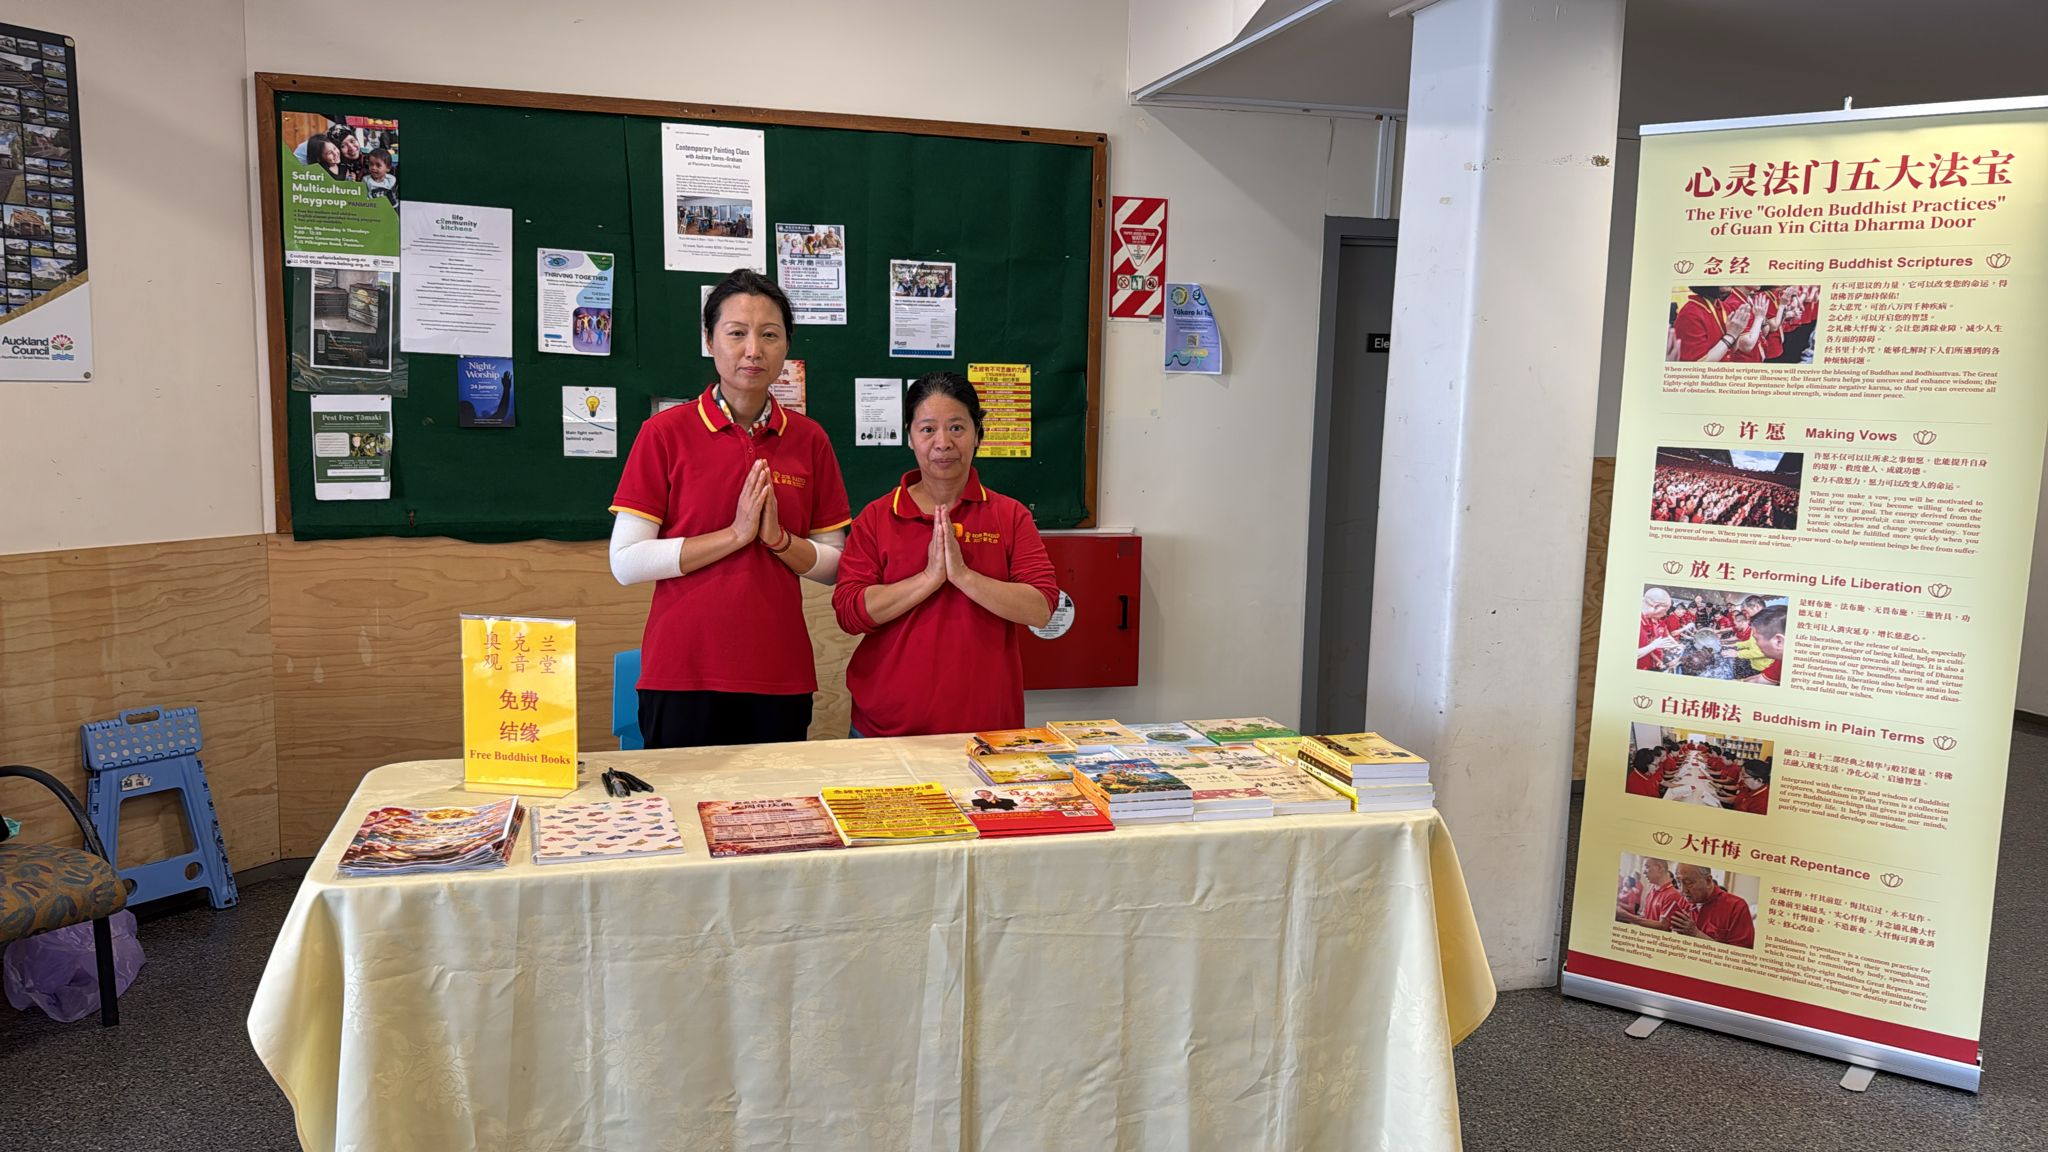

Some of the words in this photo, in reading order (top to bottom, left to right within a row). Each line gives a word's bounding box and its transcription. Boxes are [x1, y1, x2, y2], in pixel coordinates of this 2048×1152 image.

[676, 144, 713, 154] Contemporary
[714, 147, 735, 156] Painting
[292, 171, 324, 181] Safari
[1685, 150, 2015, 198] 心灵法门五大法宝
[292, 183, 361, 196] Multicultural
[292, 194, 347, 208] Playgroup
[1686, 208, 1715, 221] The
[1720, 206, 1752, 220] Five
[1758, 204, 1823, 218] "Golden
[1828, 200, 1907, 216] Buddhist
[1912, 196, 2006, 212] Practices"
[1710, 222, 1729, 236] of
[1730, 222, 1772, 235] Guan
[1777, 221, 1804, 234] Yin
[1810, 219, 1848, 233] Citta
[1854, 218, 1925, 232] Dharma
[1931, 216, 1976, 229] Door
[1704, 256, 1750, 275] 念经
[1768, 260, 1824, 272] Reciting
[1829, 256, 1893, 269] Buddhist
[1897, 256, 1973, 269] Scriptures
[2, 336, 49, 346] Auckland
[12, 346, 49, 355] Council
[466, 370, 500, 380] Worship
[469, 362, 491, 371] Night
[1739, 421, 1786, 441] 许愿
[1805, 427, 1854, 442] Making
[1860, 429, 1897, 441] Vows
[1690, 560, 1736, 580] 放生
[1742, 568, 1817, 587] Performing
[1821, 574, 1846, 587] Life
[1851, 577, 1922, 594] Liberation
[483, 632, 558, 653] 奥克兰
[1865, 641, 1890, 650] release
[1930, 648, 1966, 659] especially
[483, 653, 558, 674] 观音堂
[499, 689, 539, 712] 免费
[1661, 698, 1742, 723] 白话佛法
[500, 721, 540, 743] 结缘
[1753, 711, 1821, 730] Buddhism
[1825, 721, 1837, 732] in
[1842, 723, 1876, 738] Plain
[1880, 729, 1925, 745] Terms
[470, 750, 491, 759] Free
[494, 751, 538, 763] Buddhist
[541, 754, 570, 765] Books
[1781, 775, 1814, 788] Integrated
[1843, 786, 1865, 795] energy
[1881, 790, 1908, 800] wisdom
[1918, 796, 1949, 807] Buddhist
[1680, 834, 1741, 860] 大忏悔
[1750, 849, 1786, 865] Great
[1790, 855, 1871, 880] Repentance
[1809, 943, 1846, 958] repentance
[1859, 955, 1889, 965] common
[1890, 960, 1920, 973] practice
